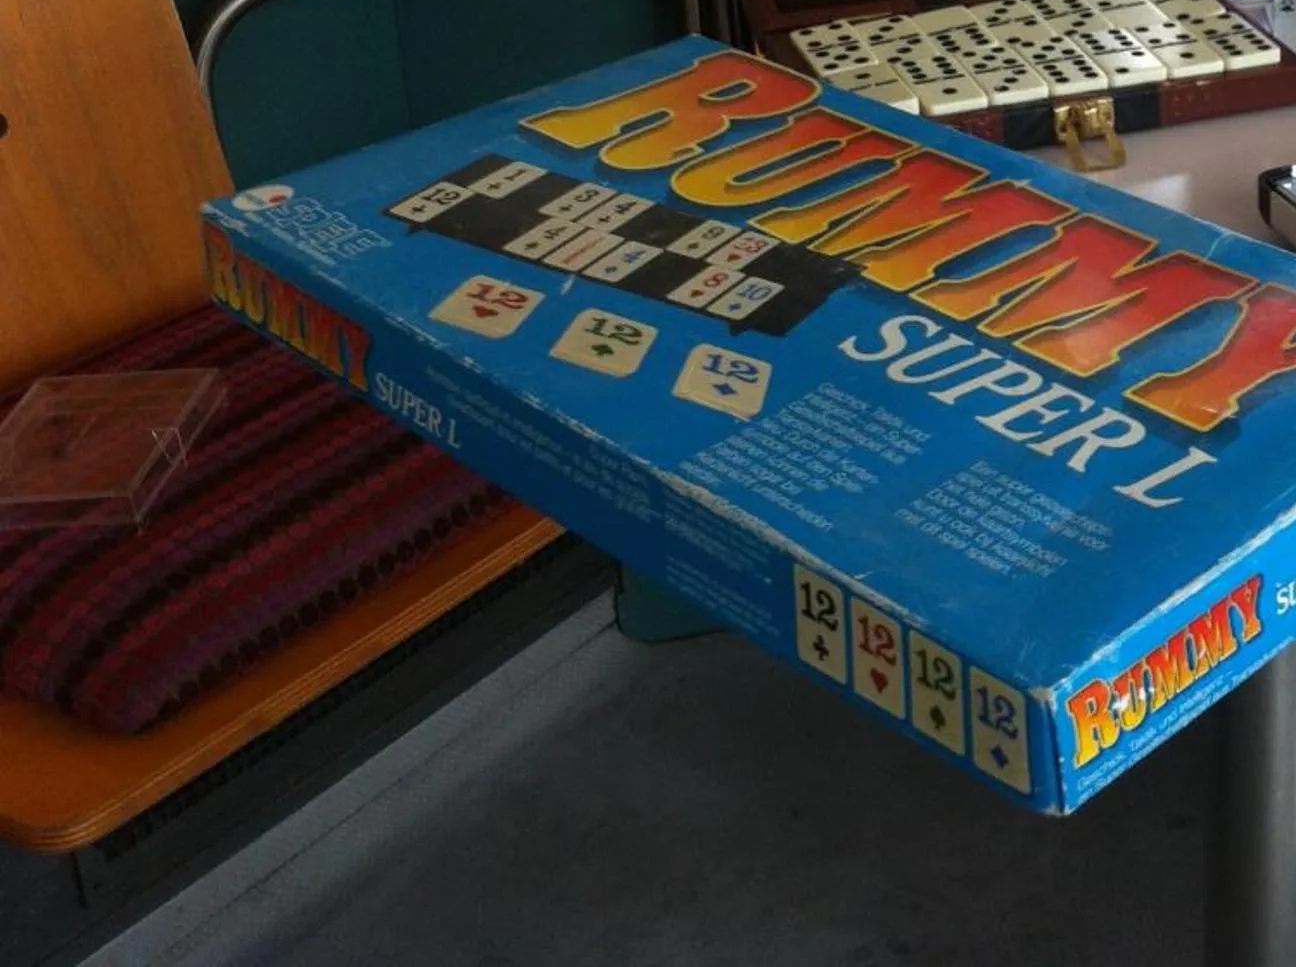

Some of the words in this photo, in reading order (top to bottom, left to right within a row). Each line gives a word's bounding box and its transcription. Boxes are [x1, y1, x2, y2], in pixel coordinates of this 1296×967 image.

[467, 283, 529, 310] 12
[203, 220, 370, 392] RUMMY
[374, 372, 443, 438] SUPER
[584, 316, 644, 346] 12
[701, 352, 761, 383] 12
[838, 313, 1146, 473] SUPER
[1112, 443, 1218, 508] L
[800, 582, 839, 632] 12
[858, 615, 897, 667] 12
[915, 649, 957, 701] 12
[1067, 573, 1263, 769] RUMMY
[976, 686, 1018, 741] 12
